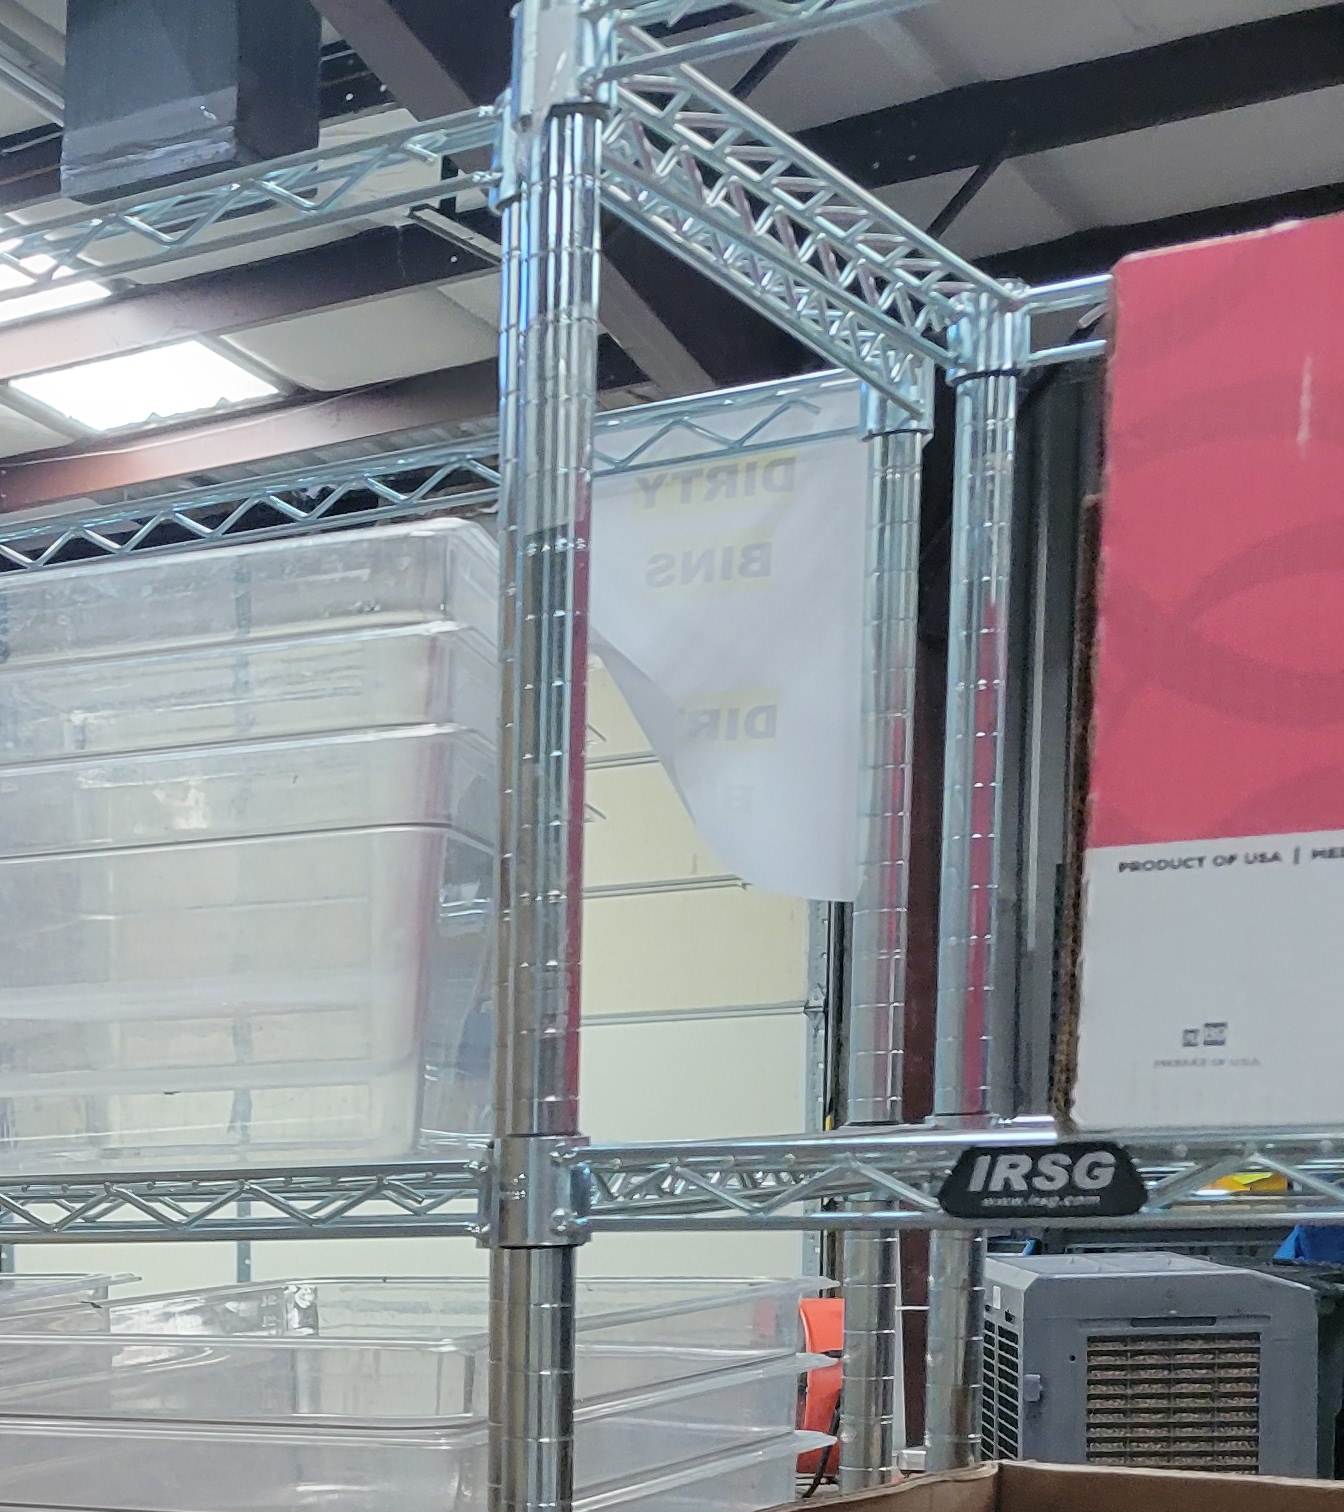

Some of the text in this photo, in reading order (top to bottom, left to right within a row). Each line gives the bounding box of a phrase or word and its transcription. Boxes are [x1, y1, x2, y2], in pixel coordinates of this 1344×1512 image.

[1118, 855, 1206, 873] PRODUCT
[1212, 852, 1238, 867] OF
[1244, 850, 1282, 865] USA
[967, 1150, 1116, 1192] IRSG
